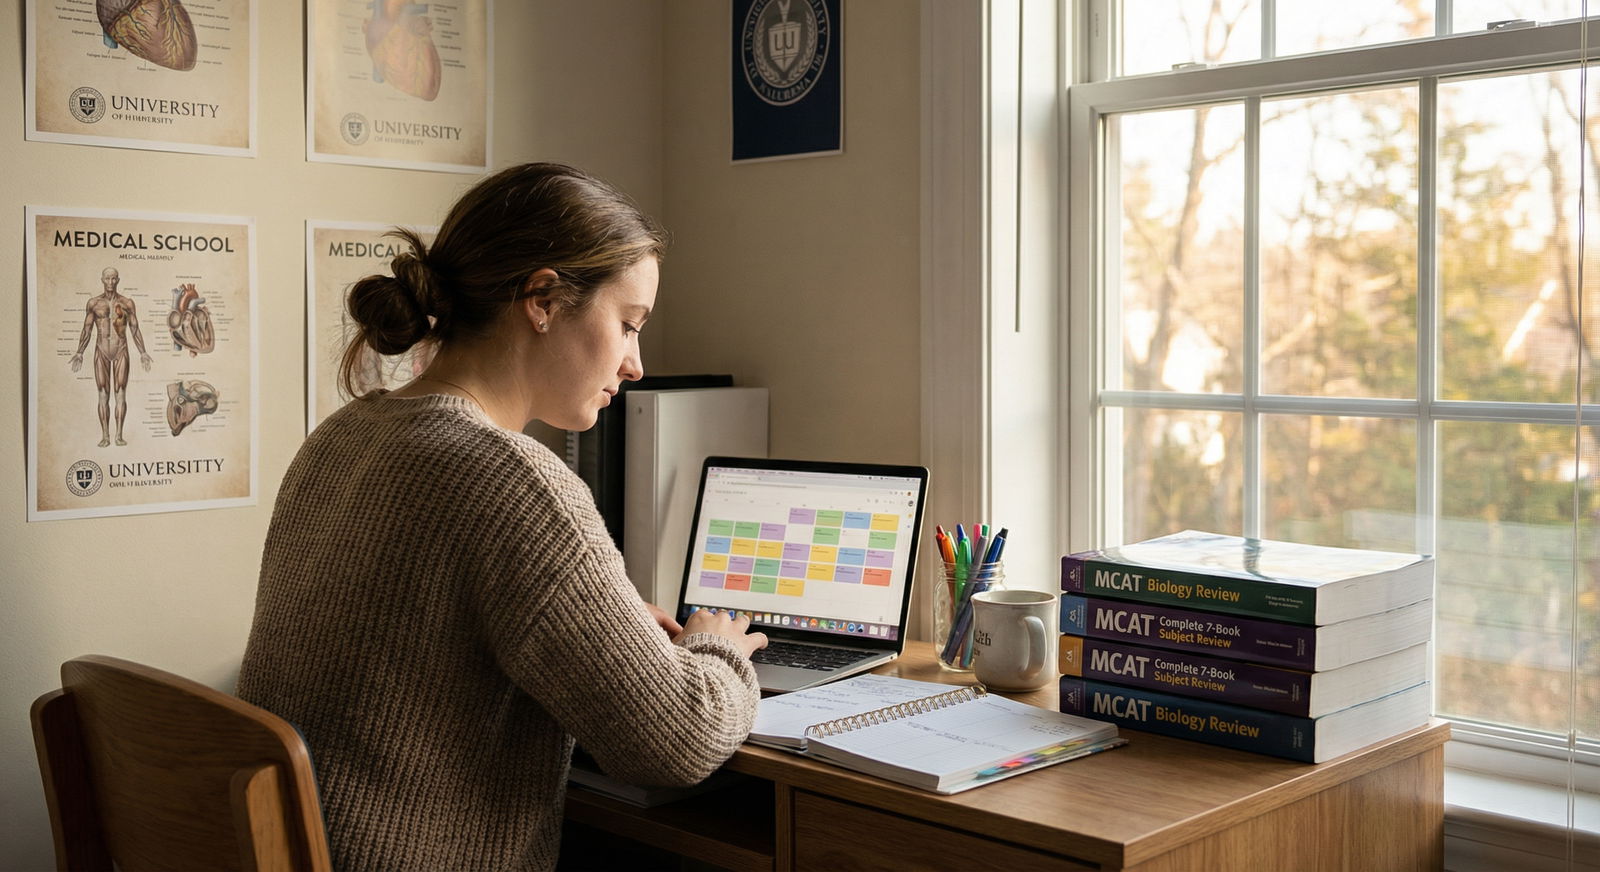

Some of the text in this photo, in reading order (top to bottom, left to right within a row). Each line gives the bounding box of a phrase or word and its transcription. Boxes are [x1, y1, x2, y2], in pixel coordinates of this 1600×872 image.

[111, 95, 219, 119] UNIVERSITY
[374, 119, 462, 141] UNIVERSITY
[54, 230, 234, 253] MEDICAL SCHOOL
[109, 458, 225, 479] UNIVERSITTY
[1094, 569, 1143, 593] MCAT
[1147, 578, 1193, 599] Biology
[1196, 584, 1240, 602] Review
[1095, 607, 1155, 637] MCAT
[1159, 615, 1204, 632] Complete
[1206, 622, 1241, 637] 7-Book
[1159, 628, 1232, 649] Subject Review
[1090, 649, 1150, 679] MCAT
[1154, 658, 1199, 675] Complete
[1200, 665, 1235, 681] 7-Book
[1154, 670, 1226, 692] Subject Review
[1093, 691, 1152, 722] MCAT
[1155, 706, 1206, 731] Biology
[1209, 715, 1260, 739] Review
